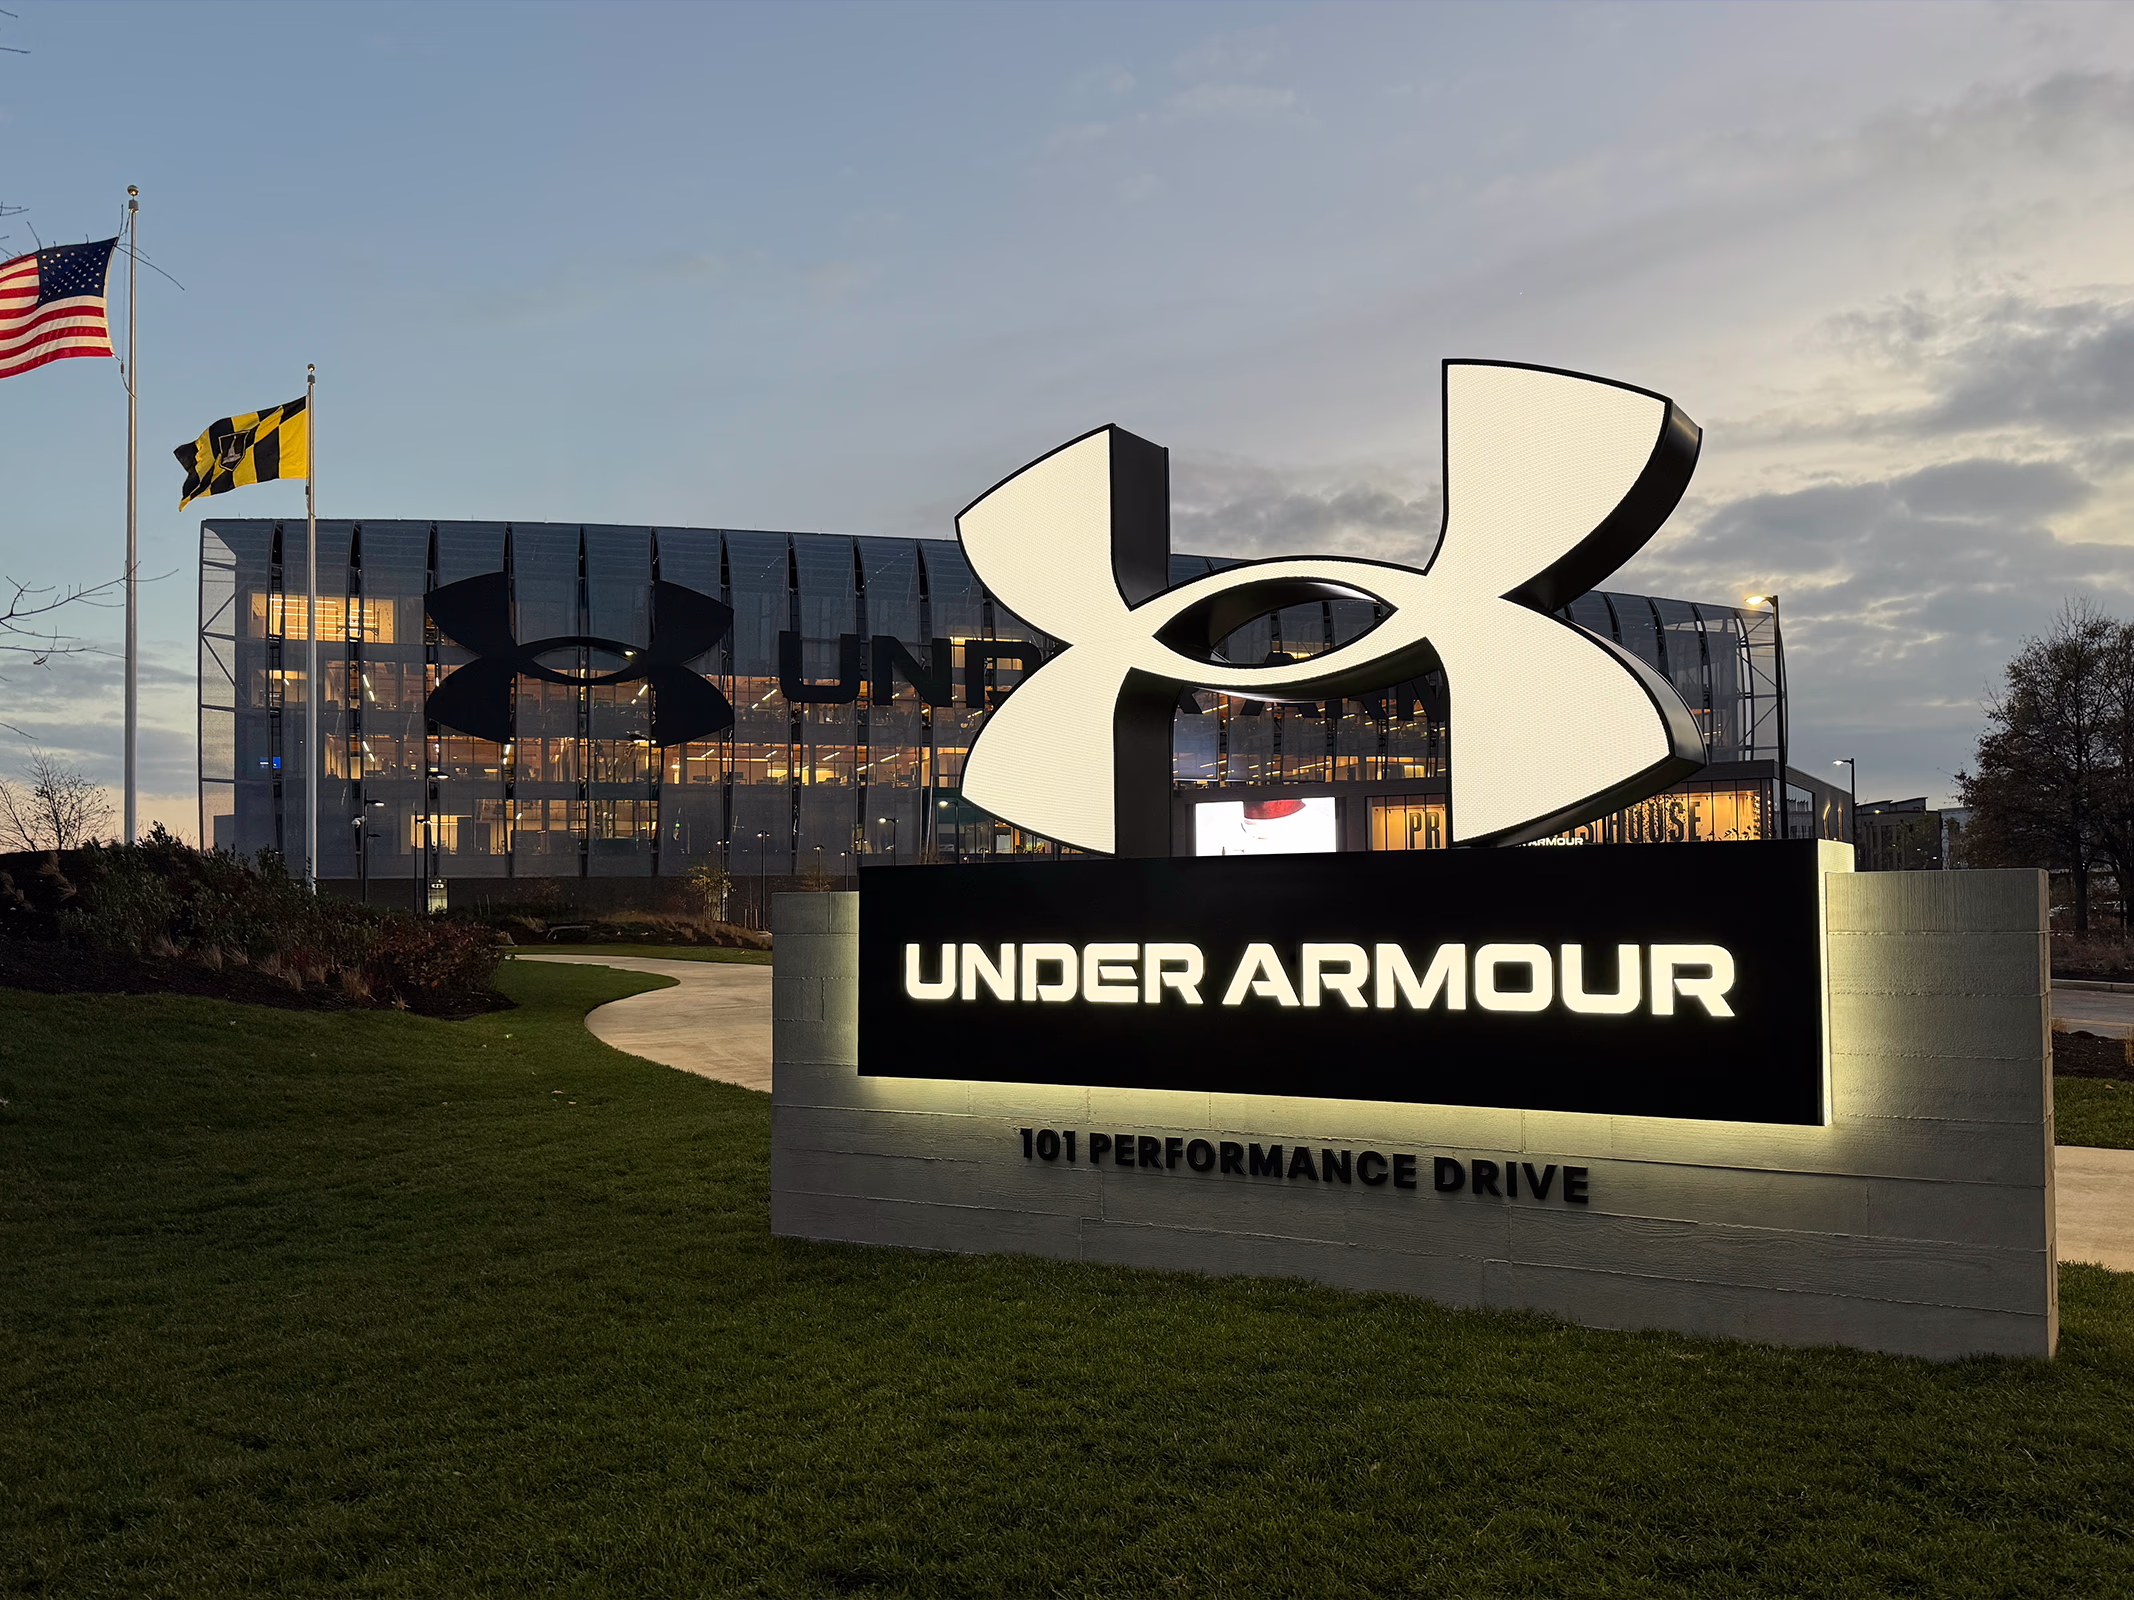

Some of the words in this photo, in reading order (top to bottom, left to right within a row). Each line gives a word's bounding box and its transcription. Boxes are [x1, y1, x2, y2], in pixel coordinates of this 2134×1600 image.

[779, 630, 1042, 708] UND
[904, 942, 1205, 1006] UNDER
[1221, 942, 1737, 1018] ARMOUR
[1020, 1128, 1077, 1163] 101
[1089, 1131, 1417, 1189] PERFORMANCE
[1433, 1157, 1590, 1204] DRIVE
